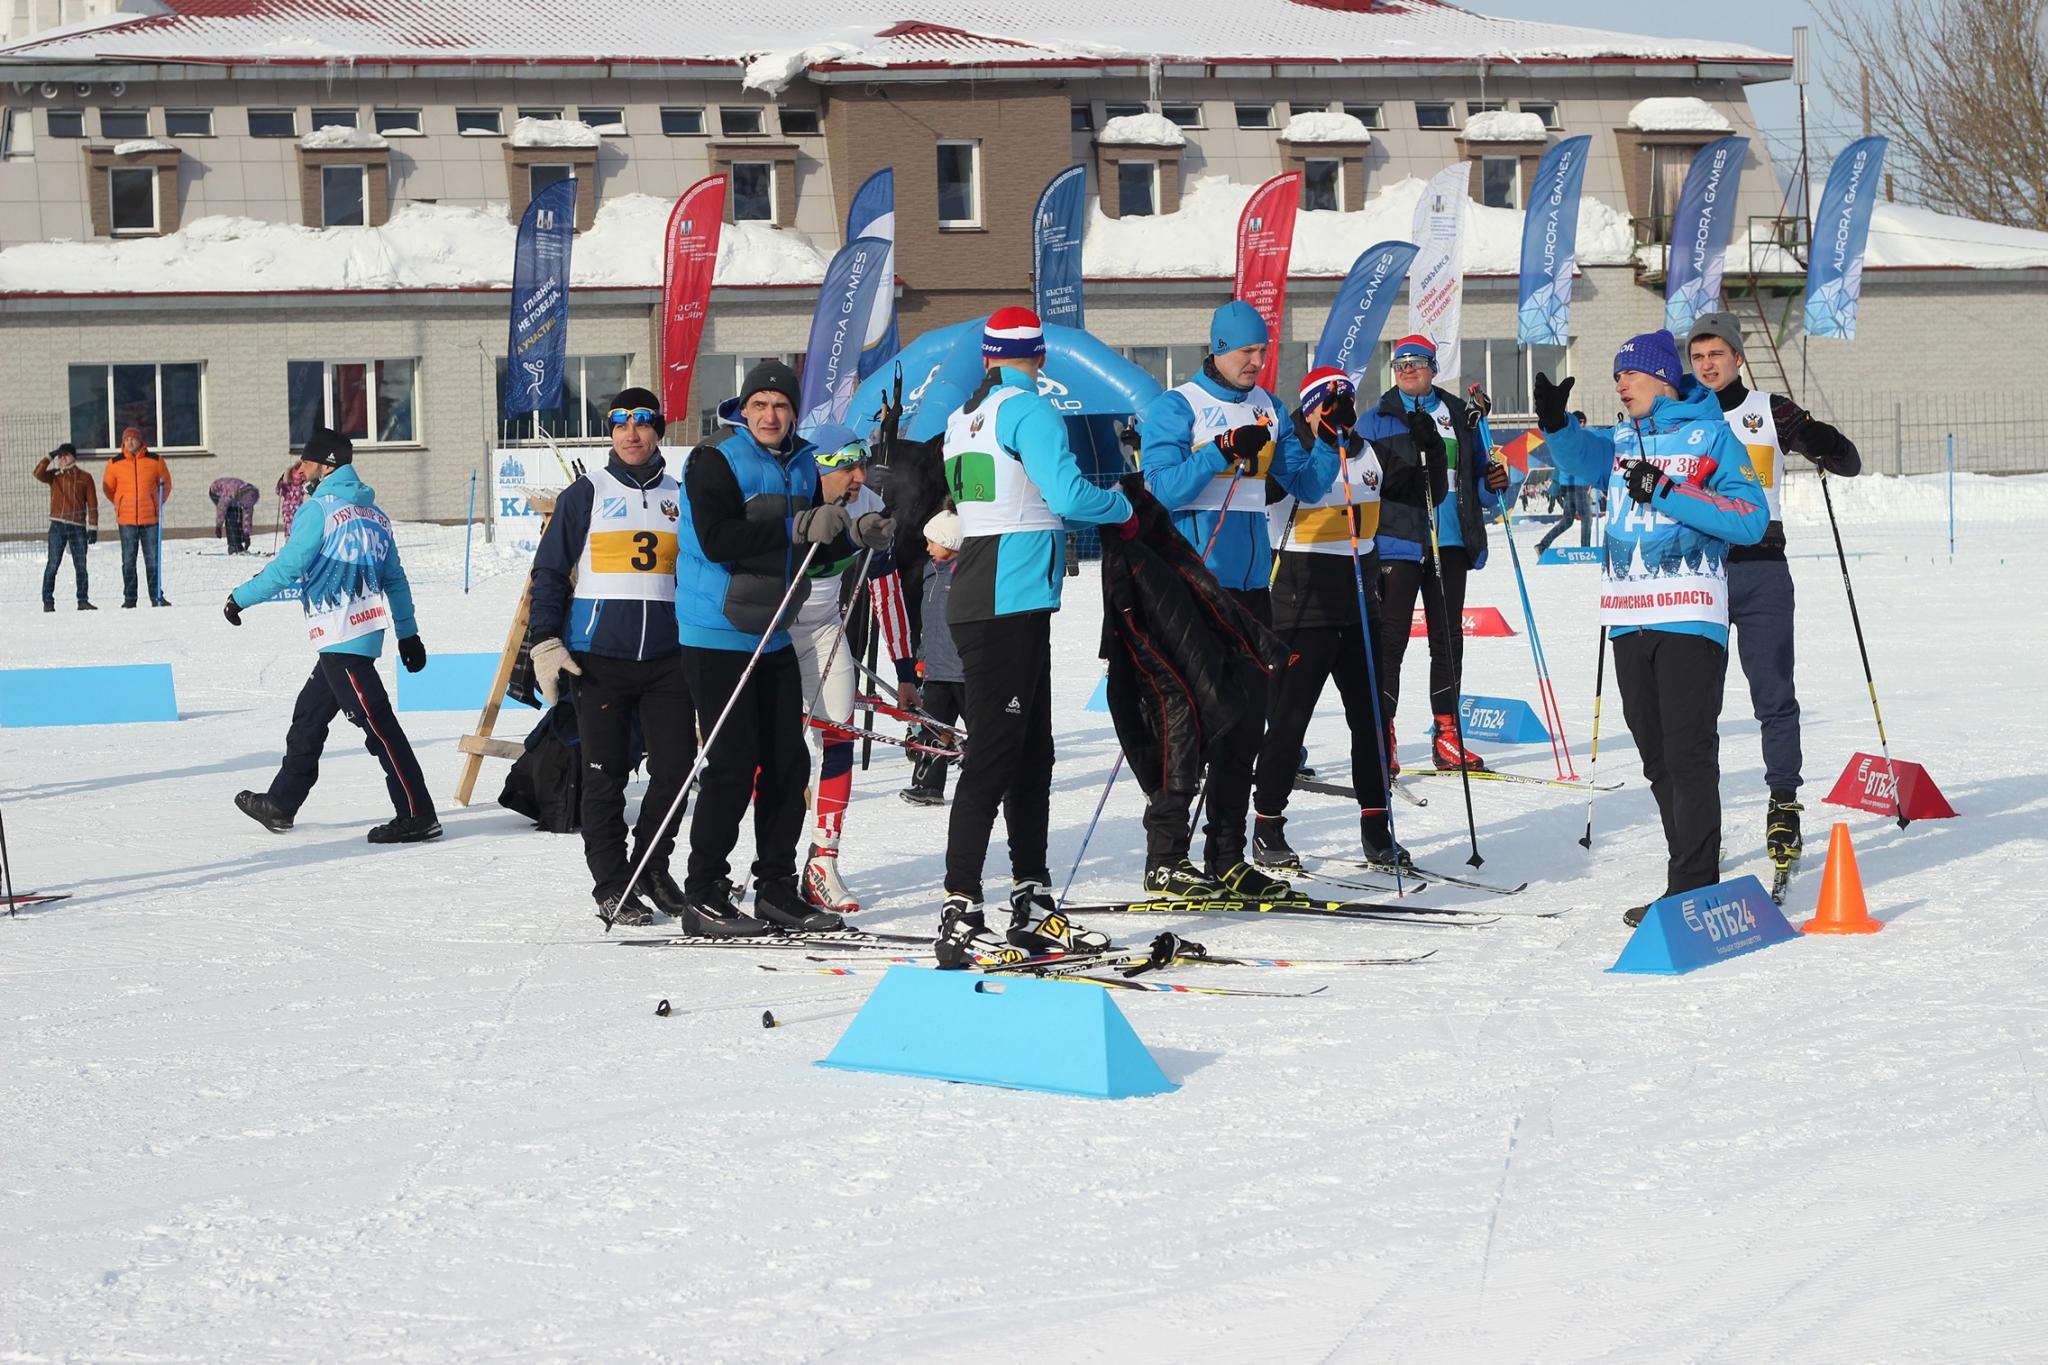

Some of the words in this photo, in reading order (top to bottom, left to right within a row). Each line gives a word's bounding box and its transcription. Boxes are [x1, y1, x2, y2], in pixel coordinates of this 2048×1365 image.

[1551, 151, 1571, 206] GAMES
[1693, 206, 1713, 272] AURORA
[1704, 149, 1727, 203] GAMES
[1833, 207, 1852, 272] AURORA
[1844, 150, 1867, 204] GAMES
[1544, 209, 1559, 277] AURORA
[517, 316, 531, 333] НЕ
[531, 290, 562, 323] ПОБЕДА,
[523, 276, 556, 313] ГЛАВНОЕ
[1336, 315, 1365, 371] URORA
[1360, 253, 1393, 311] GAMES
[825, 318, 850, 393] AURORA
[841, 251, 867, 314] GAMES
[1687, 429, 1705, 445] 8
[953, 455, 964, 500] 4
[975, 484, 985, 500] 2
[1759, 473, 1767, 486] 3
[631, 531, 659, 572] 3
[1567, 552, 1597, 561] ВТБ24
[1656, 590, 1714, 607] ОБЛАСТЬ
[1469, 709, 1506, 729] ВТБ24
[1367, 864, 1410, 876] FISCHR
[1127, 902, 1244, 912] FISCHER
[1702, 899, 1757, 942] ВТБ24
